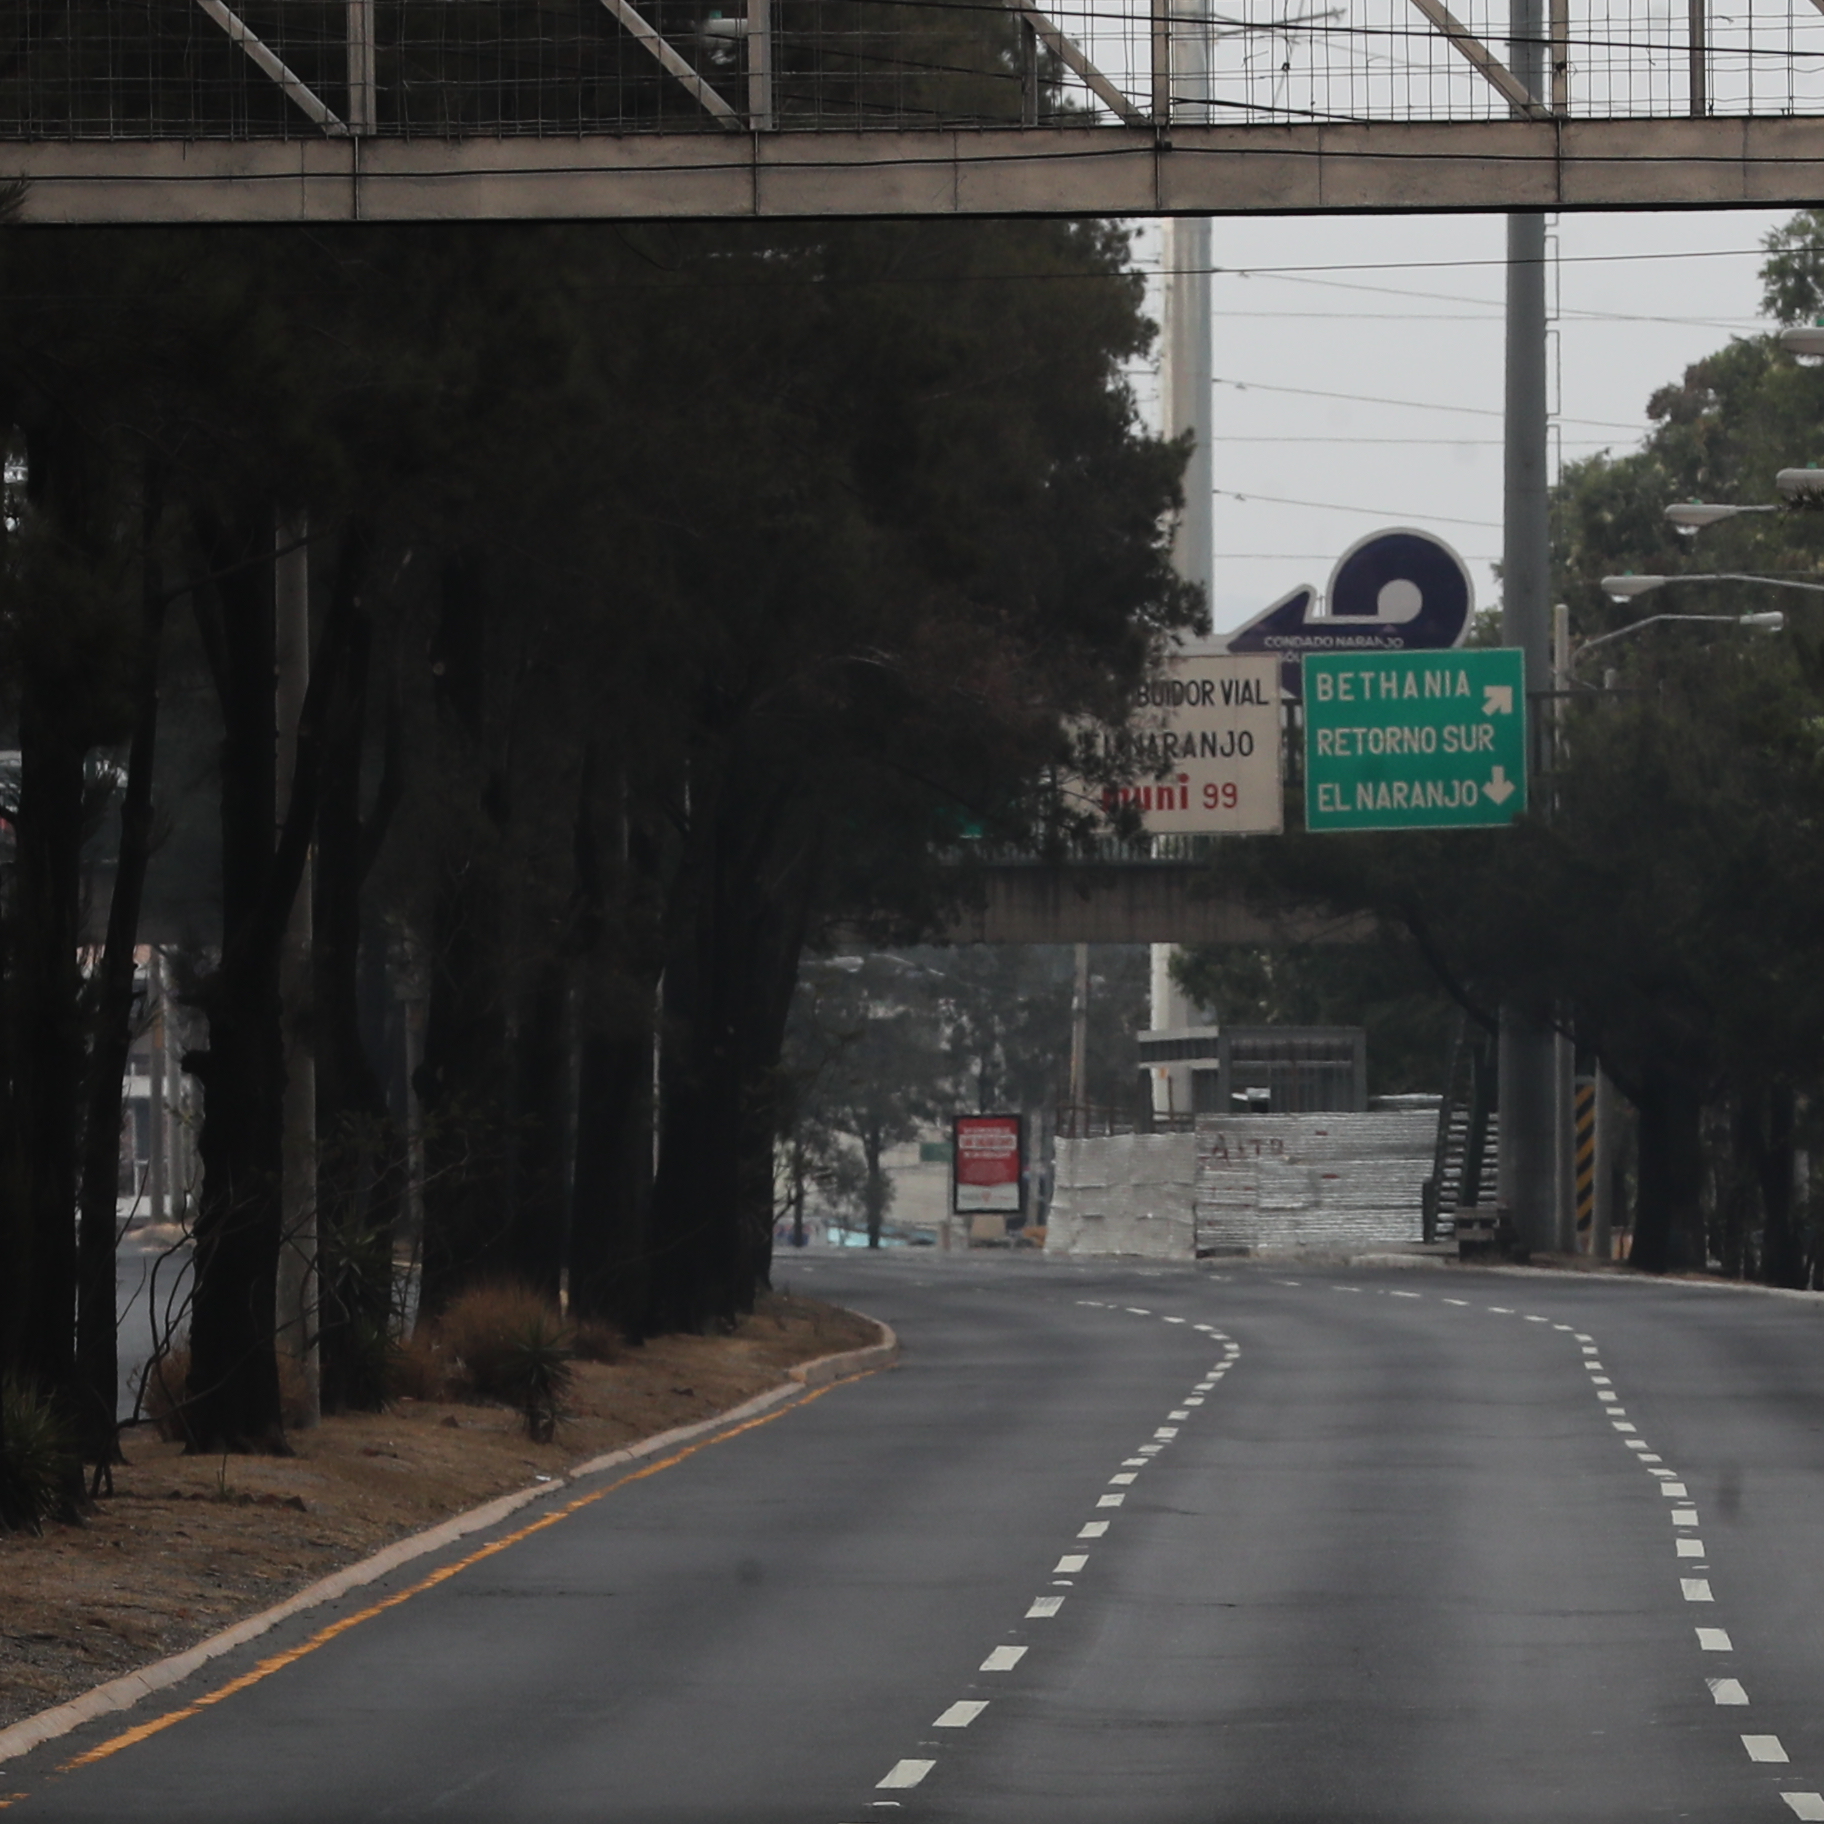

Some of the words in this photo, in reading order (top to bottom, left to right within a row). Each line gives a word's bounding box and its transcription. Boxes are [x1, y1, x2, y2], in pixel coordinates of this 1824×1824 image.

[1264, 635, 1333, 648] CONDADO
[1336, 635, 1404, 649] NARANJO
[1137, 679, 1215, 707] BUIDOR
[1220, 678, 1269, 706] VIAL
[1316, 669, 1471, 701] BETHANIA
[1317, 726, 1437, 756] RETORNO
[1442, 723, 1495, 753] SUR
[1203, 783, 1238, 809] 99
[1317, 783, 1352, 812] EL
[1356, 779, 1479, 811] NARANJO
